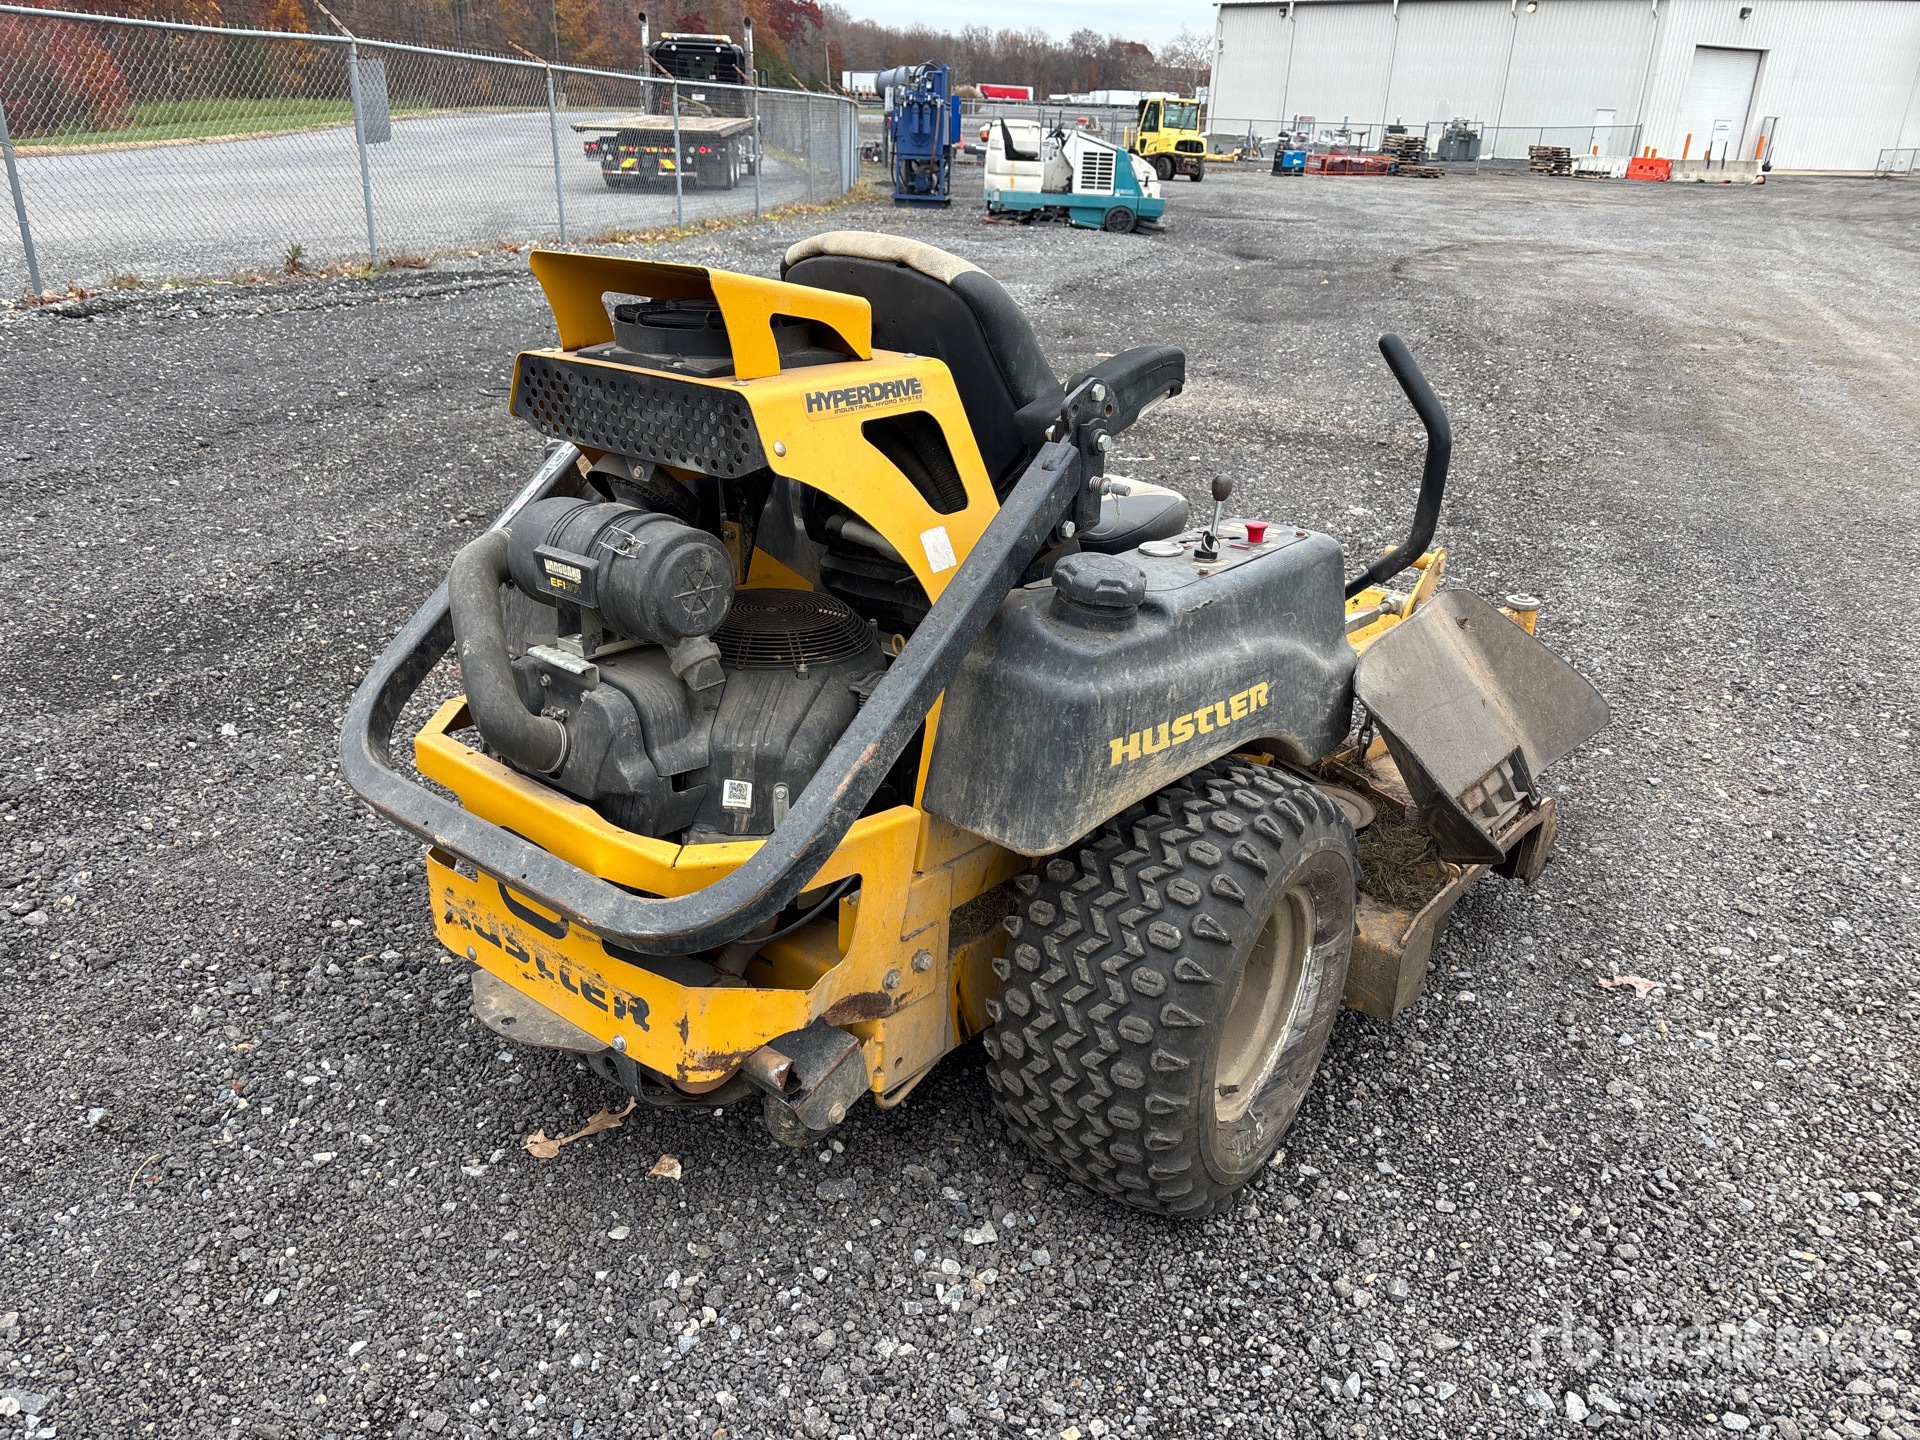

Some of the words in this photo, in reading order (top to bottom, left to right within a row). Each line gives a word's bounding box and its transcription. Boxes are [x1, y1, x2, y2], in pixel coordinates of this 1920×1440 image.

[805, 377, 922, 413] HYPERDRIVE
[875, 398, 897, 408] HYDRO
[543, 558, 582, 580] VANGUARD
[1109, 681, 1269, 767] HUSTLER
